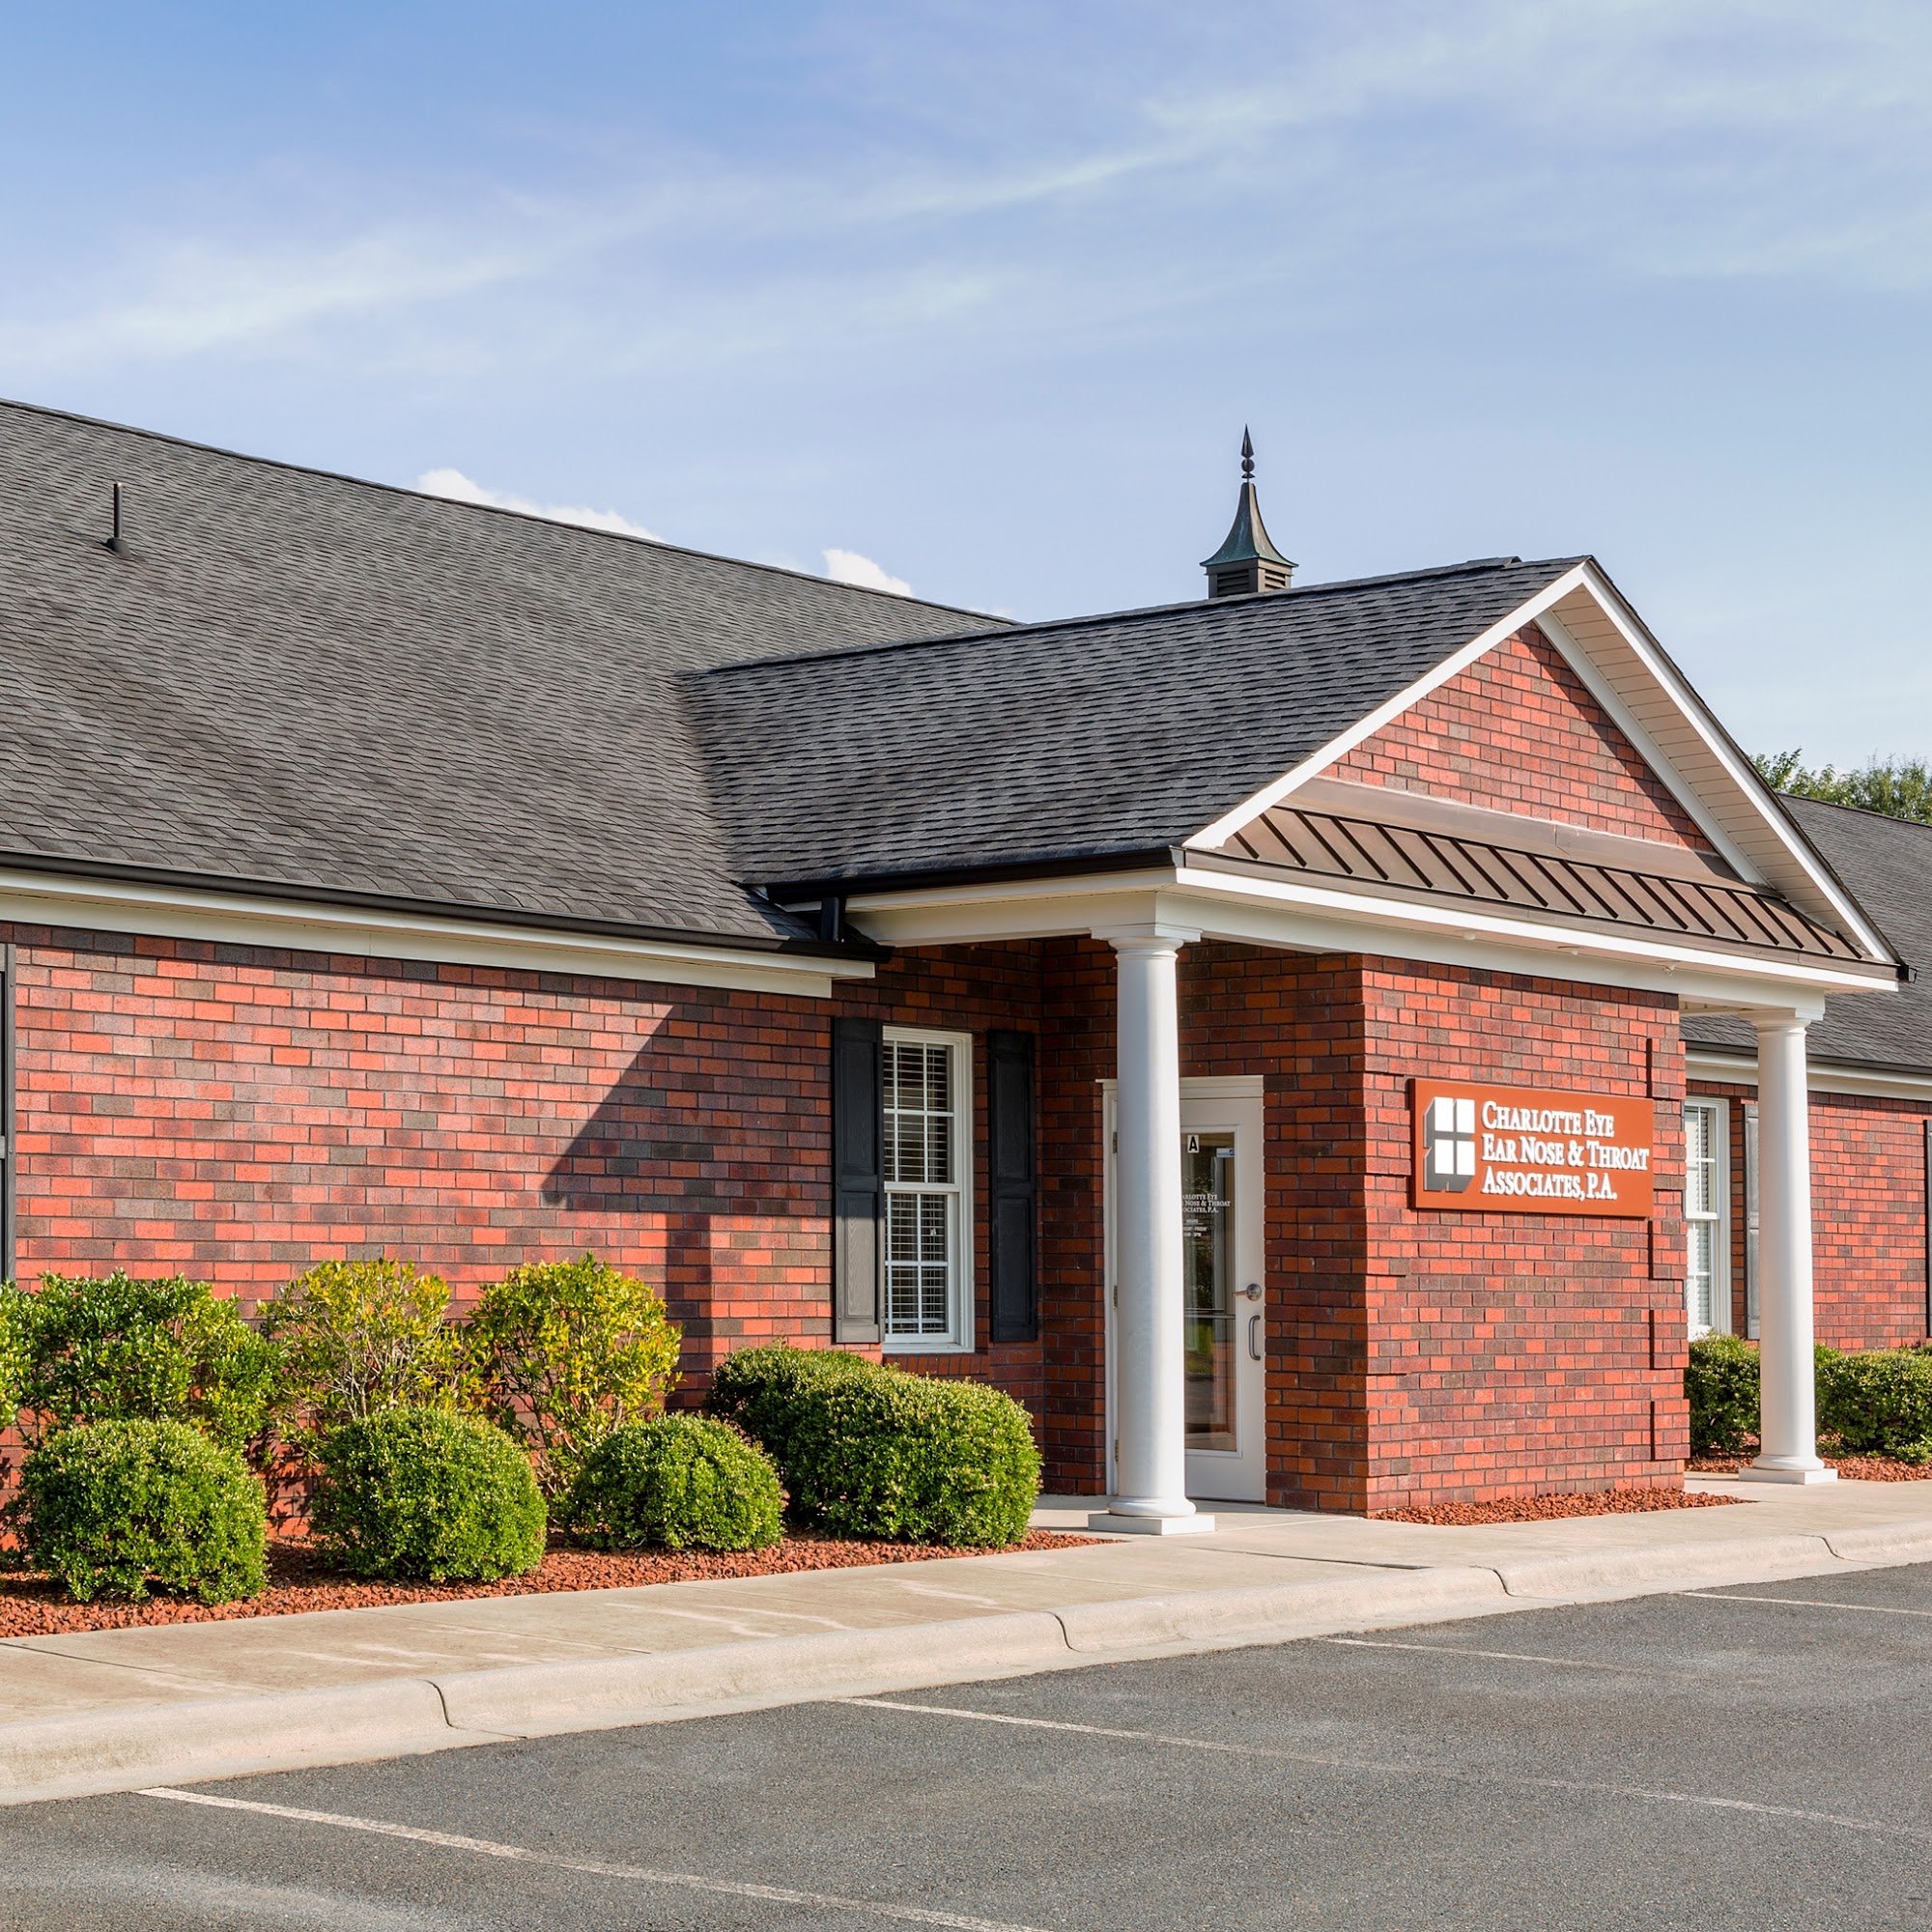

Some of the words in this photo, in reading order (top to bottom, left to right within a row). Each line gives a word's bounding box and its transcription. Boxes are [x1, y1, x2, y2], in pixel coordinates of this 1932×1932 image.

[1482, 1100, 1581, 1136] CHARLOTTE
[1584, 1109, 1615, 1138] EYE
[1189, 1136, 1198, 1151] A
[1481, 1133, 1517, 1162] EAR
[1520, 1136, 1564, 1166] NOSE
[1567, 1140, 1584, 1168] &
[1586, 1140, 1650, 1171] THROAT
[1482, 1166, 1585, 1201] ASSOCIATES,
[1586, 1173, 1618, 1201] P.A.
